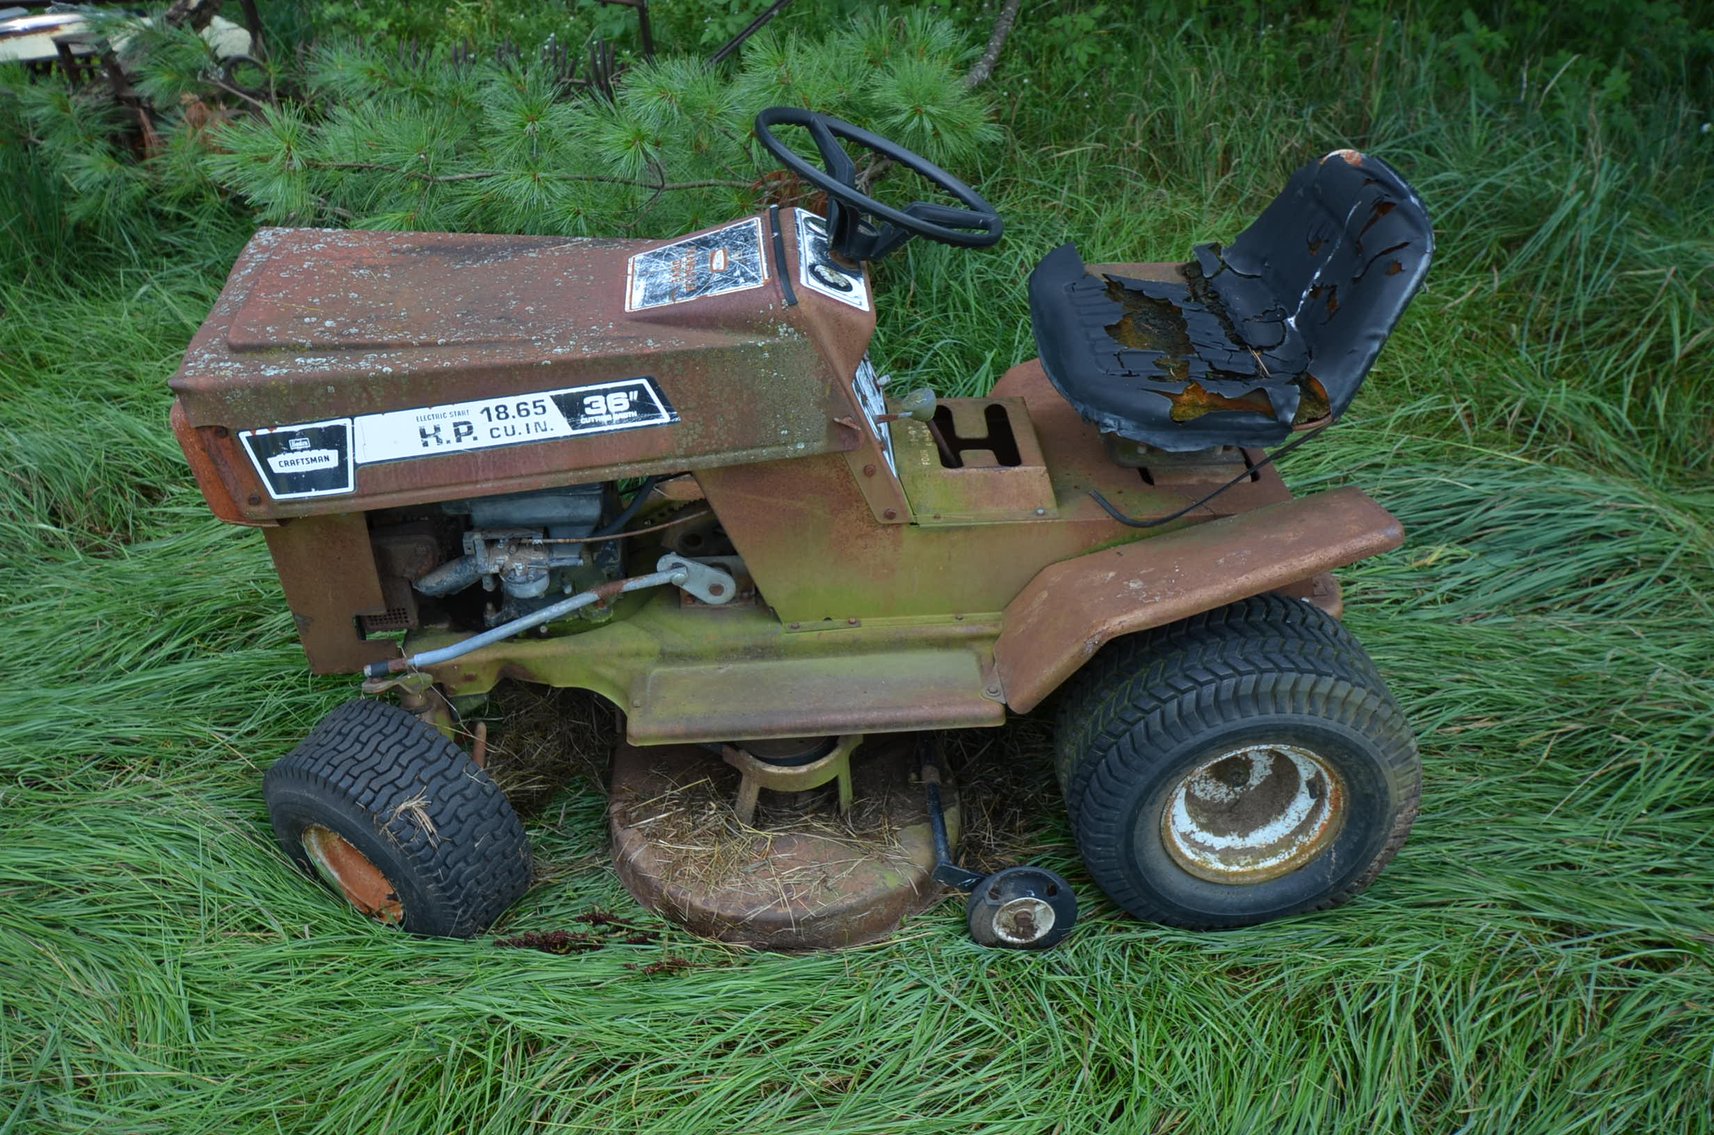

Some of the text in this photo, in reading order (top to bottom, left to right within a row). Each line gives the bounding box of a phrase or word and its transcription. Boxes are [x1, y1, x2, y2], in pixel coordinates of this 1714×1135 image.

[583, 391, 638, 415] 36"
[416, 409, 470, 423] ELECTRIC START
[480, 399, 547, 422] 18.65
[580, 414, 612, 424] CUTT
[278, 455, 330, 468] CRAFTSMAN
